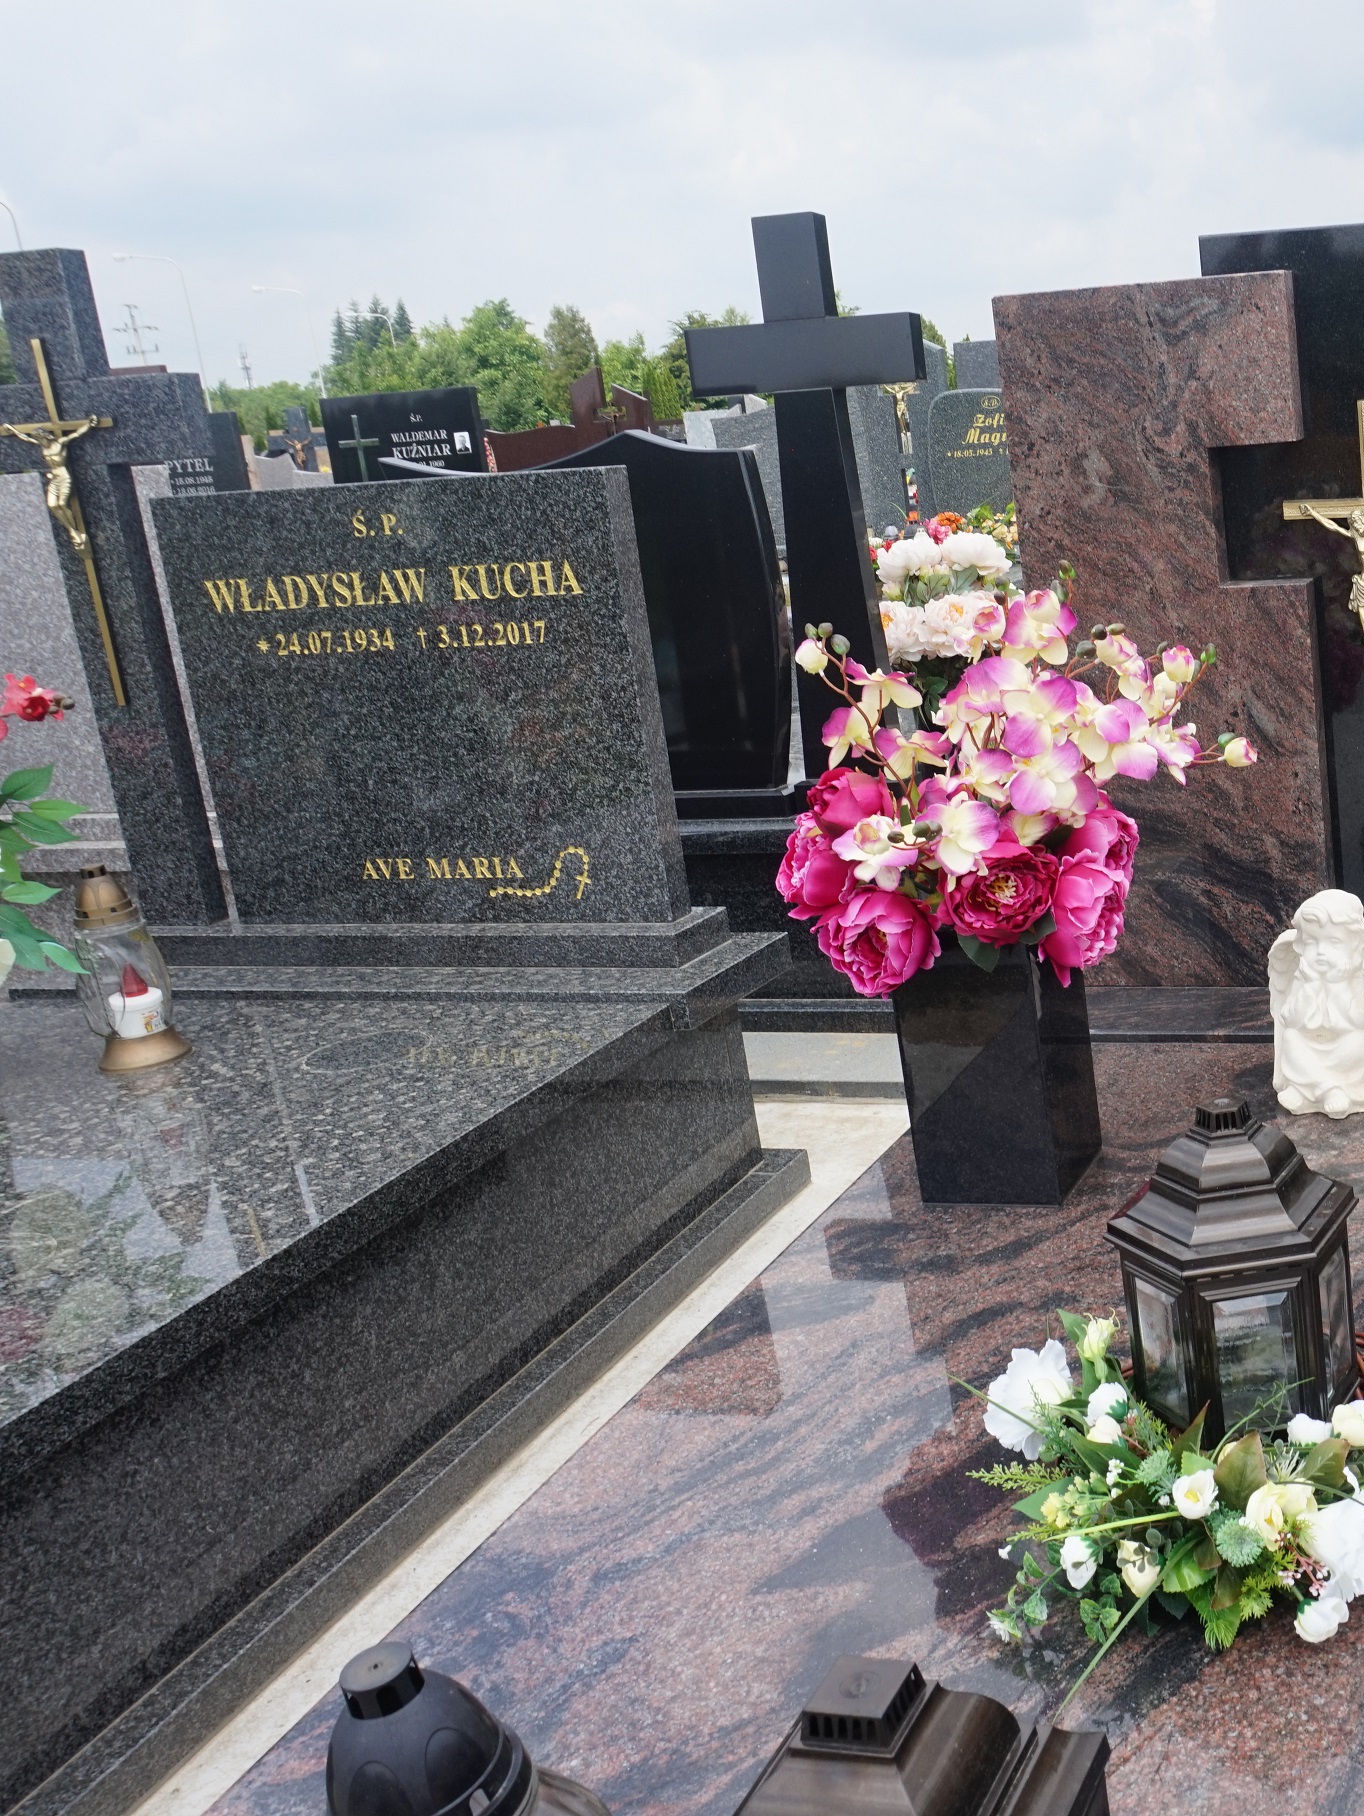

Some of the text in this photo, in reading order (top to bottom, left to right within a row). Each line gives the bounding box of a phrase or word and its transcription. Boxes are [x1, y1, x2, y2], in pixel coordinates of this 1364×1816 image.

[391, 429, 448, 443] WALDEMAR
[392, 443, 452, 459] KUŹNIAR
[204, 558, 584, 614] WŁADYSŁAW KUCHA
[275, 620, 546, 656] 24.07.1934 3.12.2017
[362, 857, 525, 880] AVE MARIA
